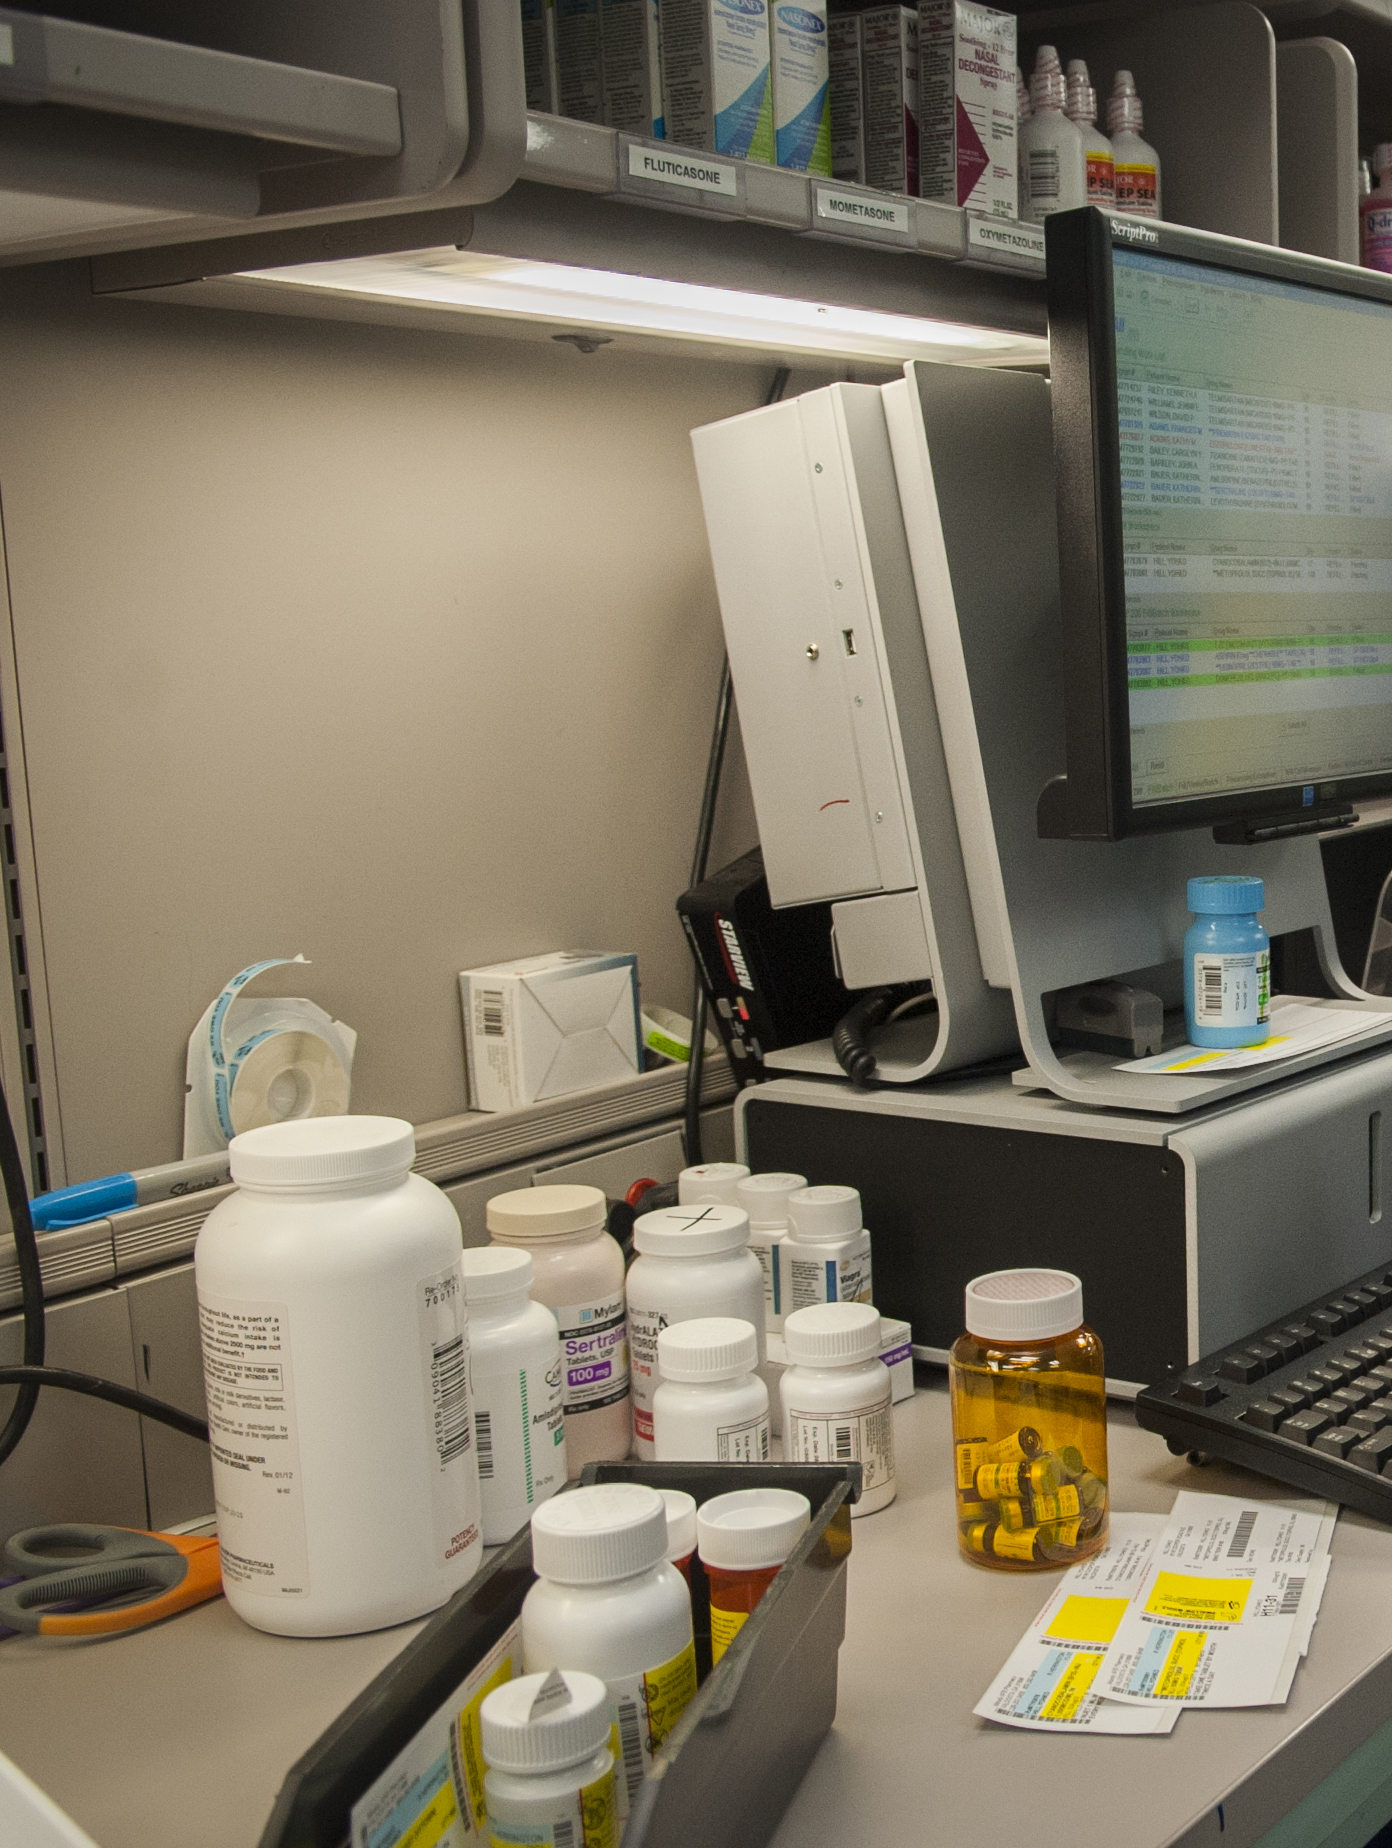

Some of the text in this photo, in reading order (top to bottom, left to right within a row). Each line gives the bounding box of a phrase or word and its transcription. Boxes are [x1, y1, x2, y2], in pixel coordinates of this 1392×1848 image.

[974, 48, 1000, 66] NASAL
[958, 58, 1016, 83] DECONGESTANT
[979, 77, 998, 91] Spray
[643, 157, 721, 185] FLUTICASONE
[1137, 188, 1156, 200] SEA
[829, 199, 896, 223] MOMETASONE
[980, 227, 1045, 252] OXYMETAZOLINE
[1111, 220, 1156, 242] ScriptPro
[718, 919, 755, 991] STARVIEW
[840, 1271, 861, 1283] Viagra
[216, 1320, 234, 1329] reduce
[238, 1323, 249, 1331] the
[217, 1329, 239, 1339] calcium
[244, 1333, 267, 1341] intake
[565, 1325, 627, 1356] Sertralin
[244, 1343, 255, 1351] mg
[566, 1347, 614, 1366] Tablets, USP
[569, 1366, 610, 1383] 100 mg
[246, 1455, 266, 1464] UNDER
[262, 1471, 293, 1479] Rev. 01/12
[451, 1522, 475, 1547] POTENCY
